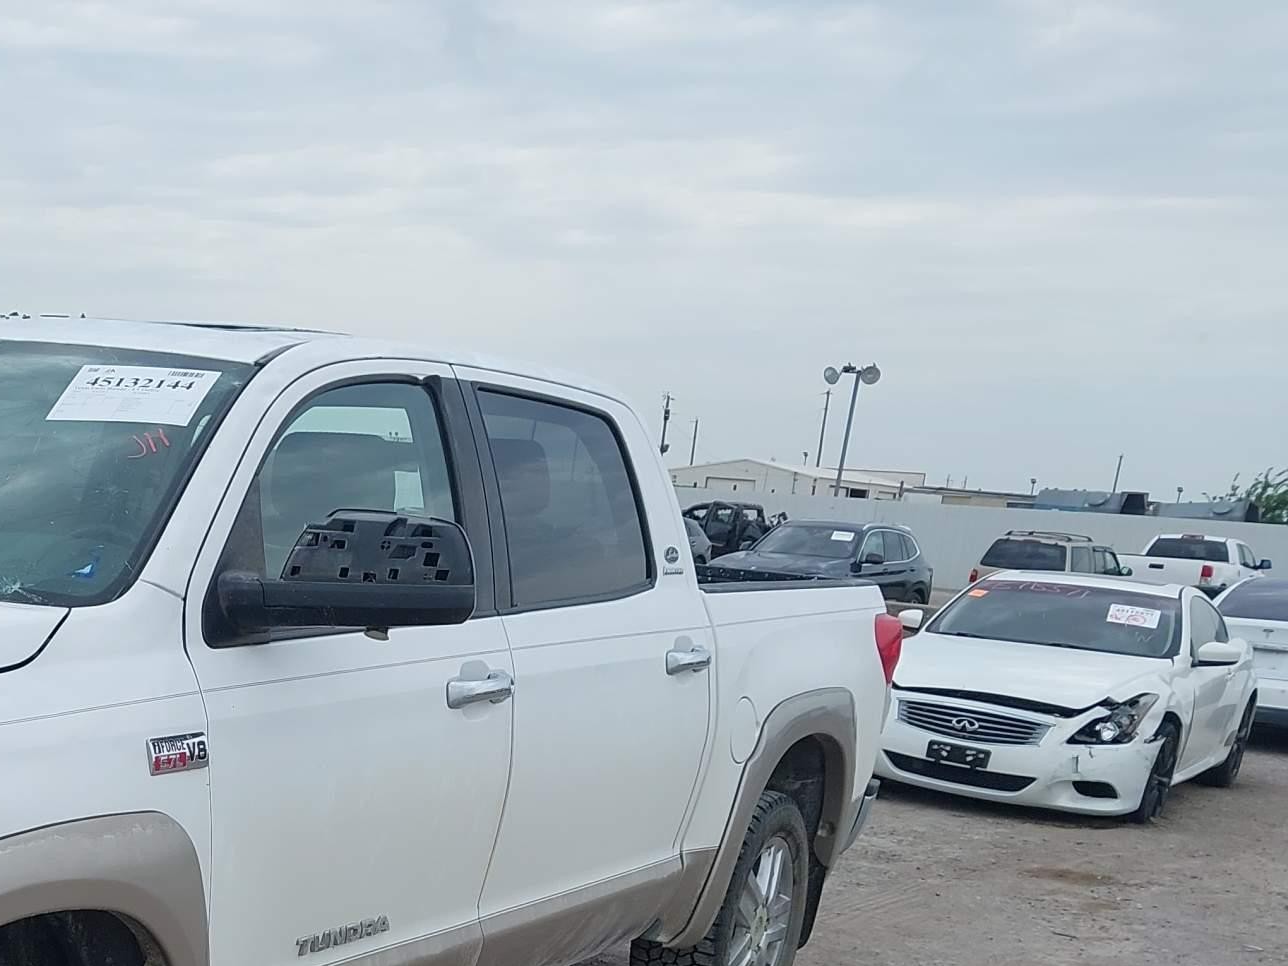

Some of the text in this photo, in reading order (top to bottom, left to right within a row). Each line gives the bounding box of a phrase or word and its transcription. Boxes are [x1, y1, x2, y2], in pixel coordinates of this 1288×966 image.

[86, 376, 196, 391] 45132144
[186, 740, 208, 762] V8
[296, 915, 390, 957] TUNDRA
